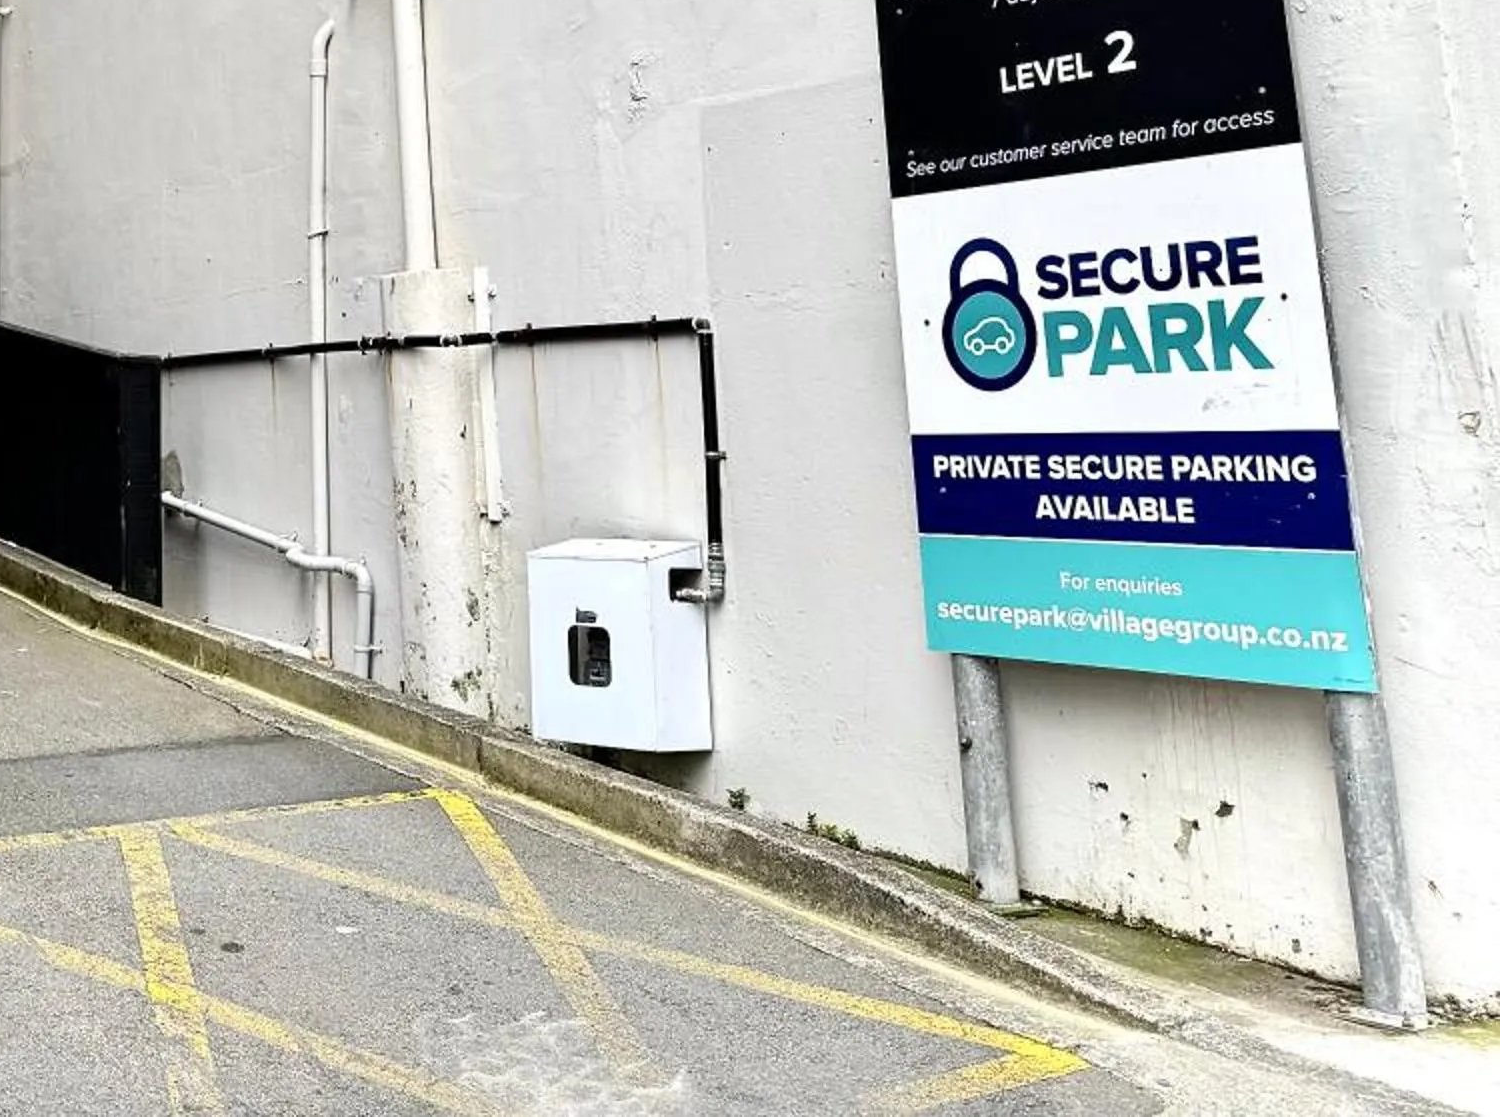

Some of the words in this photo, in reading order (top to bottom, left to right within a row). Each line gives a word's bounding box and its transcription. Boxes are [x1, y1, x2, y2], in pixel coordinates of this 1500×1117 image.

[999, 52, 1093, 94] LEVEL
[1104, 30, 1137, 74] 2
[906, 159, 936, 178] See
[940, 156, 967, 173] our
[970, 141, 1047, 169] customer
[1051, 133, 1113, 156] service
[1119, 125, 1167, 146] team
[1172, 117, 1199, 139] for
[1204, 109, 1275, 134] access
[1035, 235, 1263, 300] SECURE
[1042, 296, 1275, 378] PARK
[933, 455, 1041, 480] PRIVATE
[1047, 455, 1164, 481] SECURE
[1171, 455, 1317, 483] PARKING
[1036, 494, 1195, 524] AVAILABLE
[1060, 571, 1090, 590] For
[1095, 573, 1183, 596] enquiries
[937, 599, 1349, 652] securepark@villagegroup.co.nz
